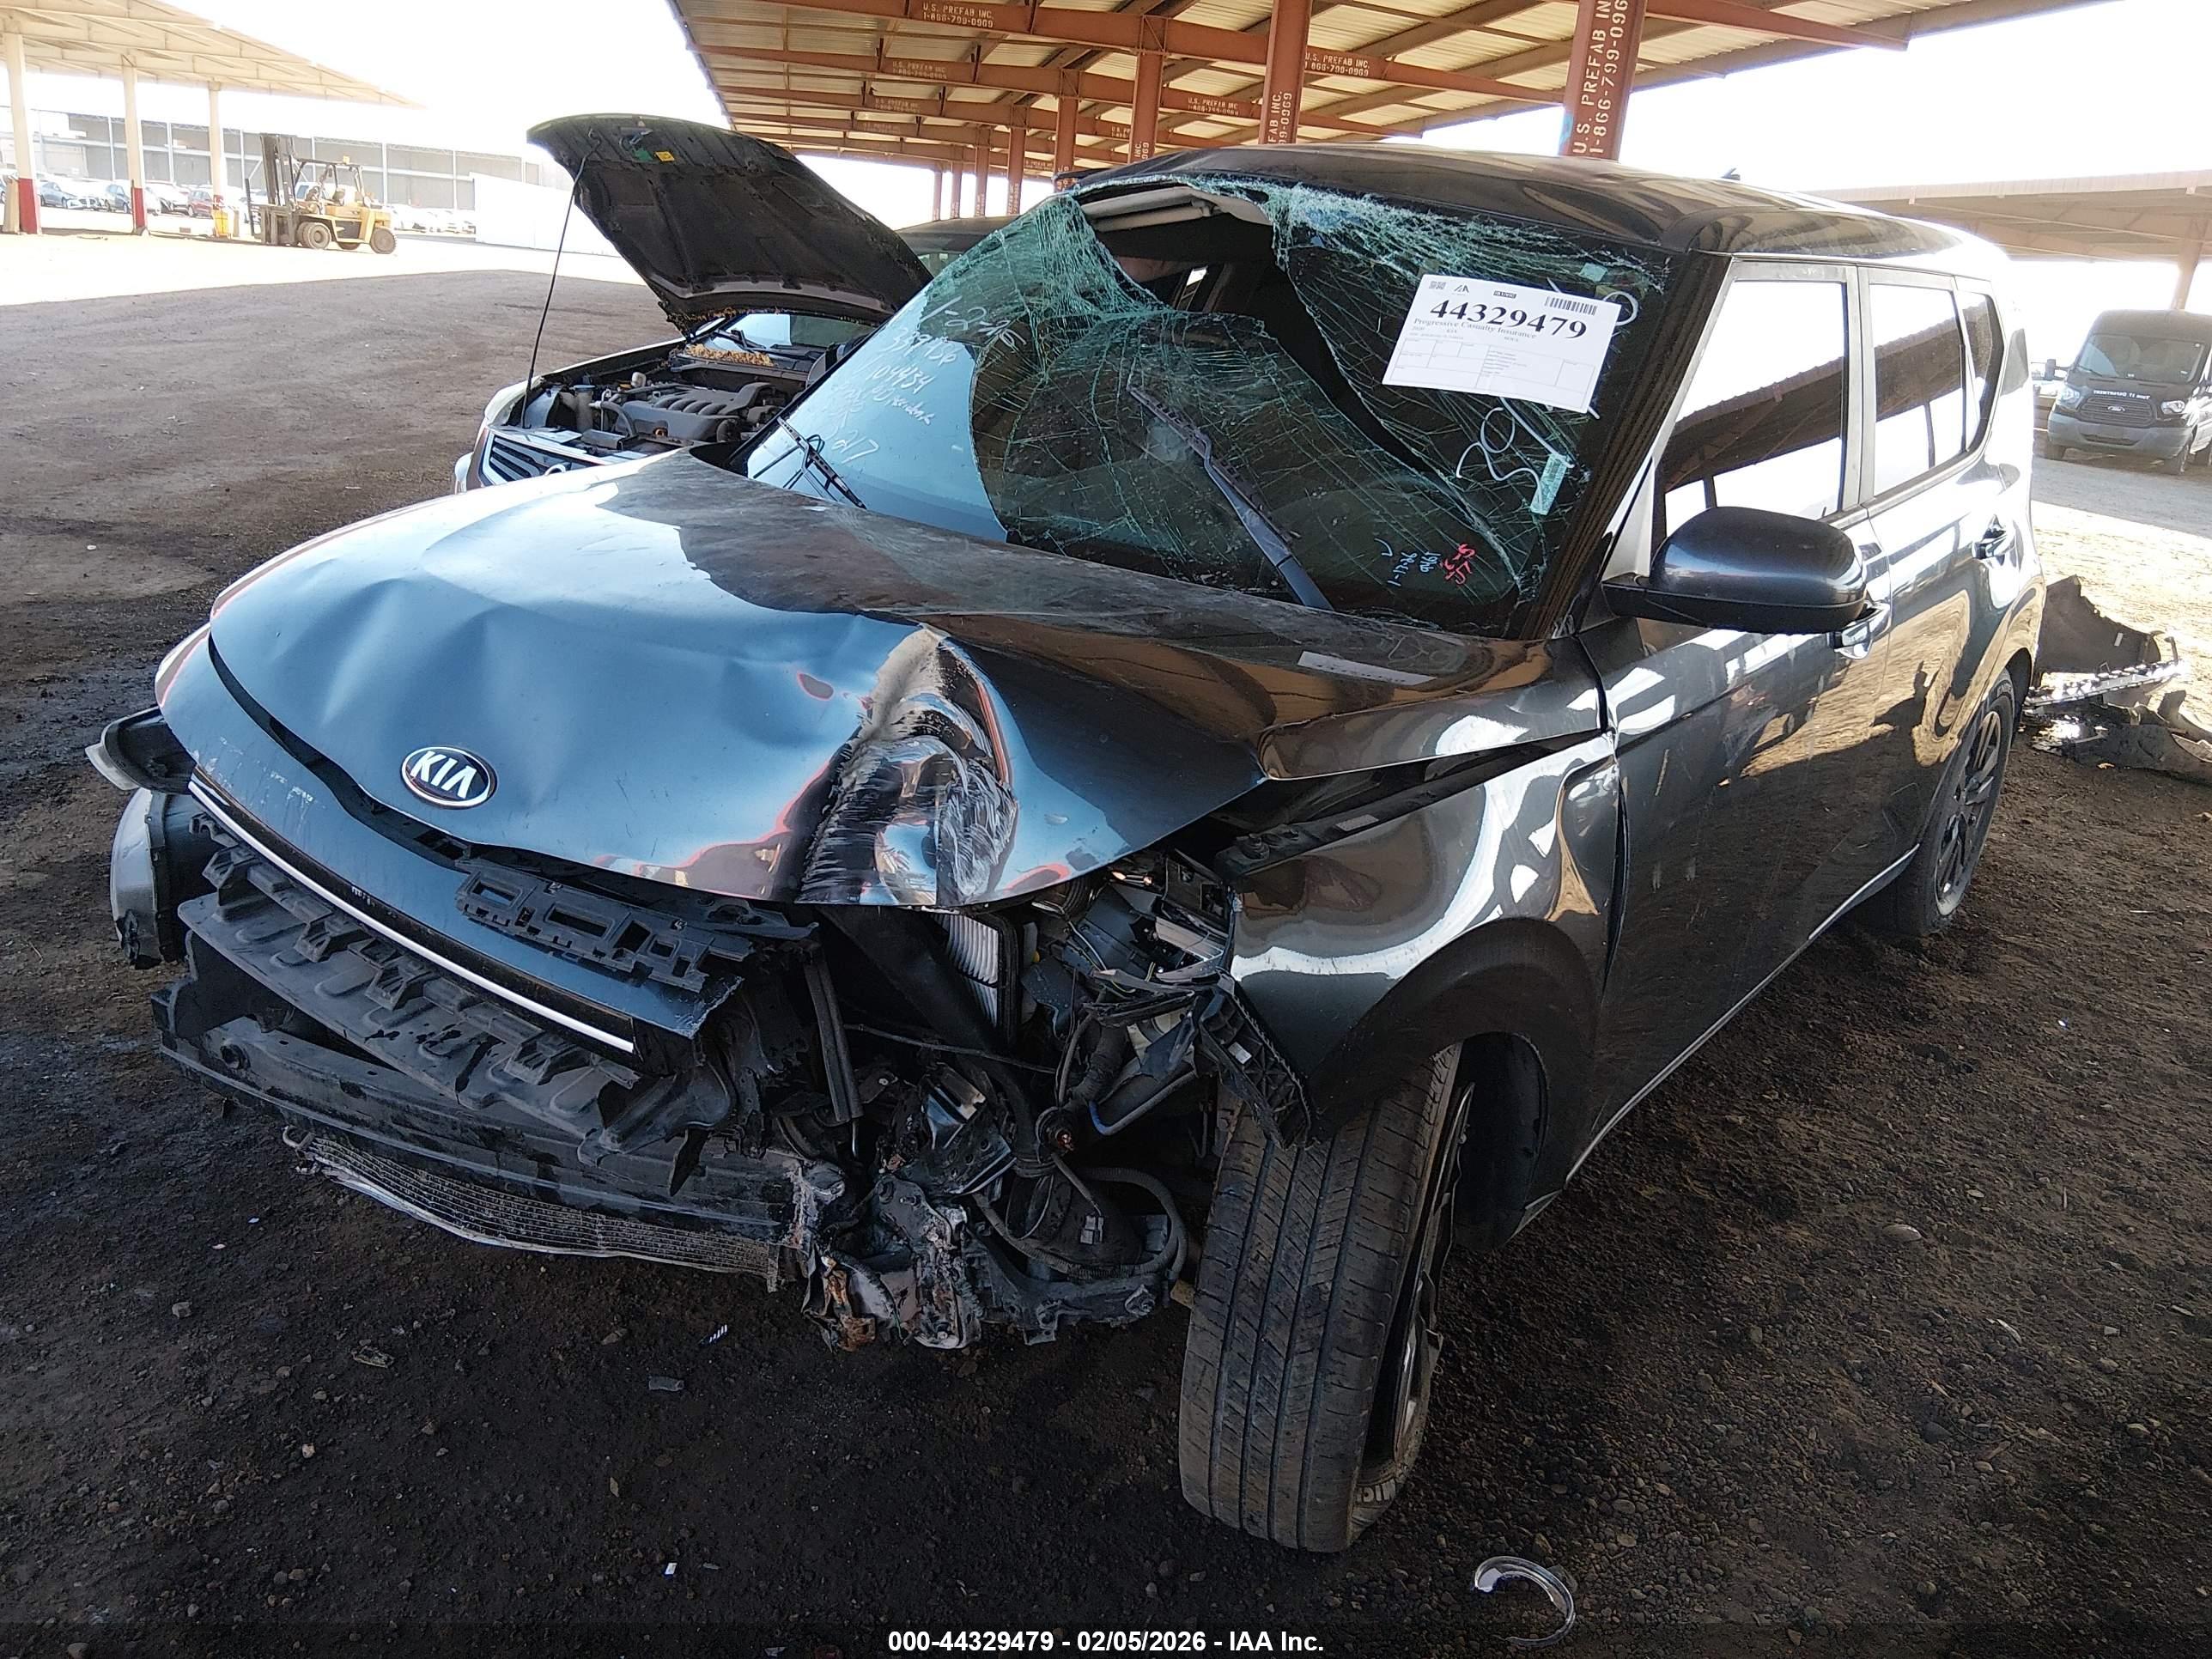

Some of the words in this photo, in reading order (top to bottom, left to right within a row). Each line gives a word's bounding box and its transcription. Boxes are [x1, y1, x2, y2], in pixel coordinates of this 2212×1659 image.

[922, 3, 939, 12] U.S.
[943, 5, 975, 16] PREFAB
[979, 9, 994, 20] INC.
[923, 11, 994, 28] 1-866-799-0969
[1323, 55, 1352, 65] PREFAB
[1356, 59, 1370, 69] INC.
[1581, 29, 1607, 106] PREFAB
[1271, 91, 1282, 113] INC.
[1572, 118, 1592, 154] U.S.
[1413, 318, 1460, 329] Progressive
[1461, 322, 1496, 333] Casualty
[1498, 327, 1537, 339] Insurance
[1429, 300, 1587, 340] 44329479
[410, 750, 477, 799] KIA
